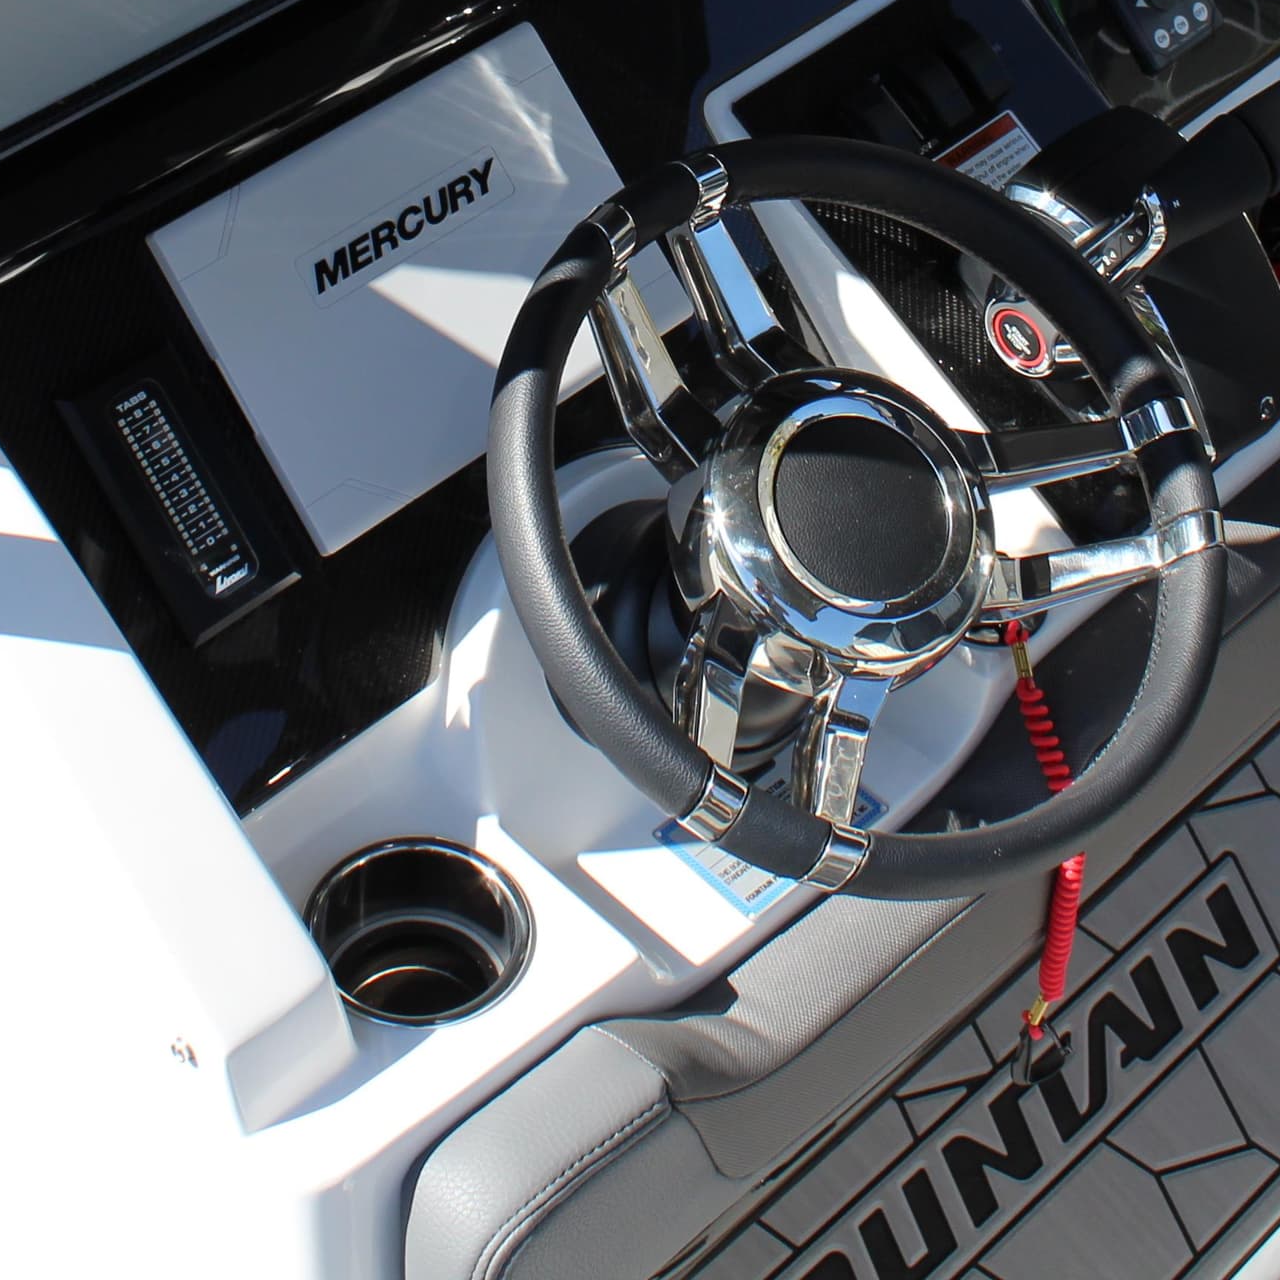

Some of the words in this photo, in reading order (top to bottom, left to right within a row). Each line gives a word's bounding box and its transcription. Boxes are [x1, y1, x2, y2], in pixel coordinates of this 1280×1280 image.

[314, 157, 494, 295] MERCURY
[115, 391, 147, 413] TABS
[142, 424, 151, 434] 7
[170, 472, 180, 482] 4
[179, 488, 189, 498] 3
[187, 503, 197, 514] 2
[198, 520, 206, 529] 1
[206, 536, 215, 546] 0
[745, 878, 774, 903] FOUNTAIN
[800, 883, 1260, 1280] UNTAIN
